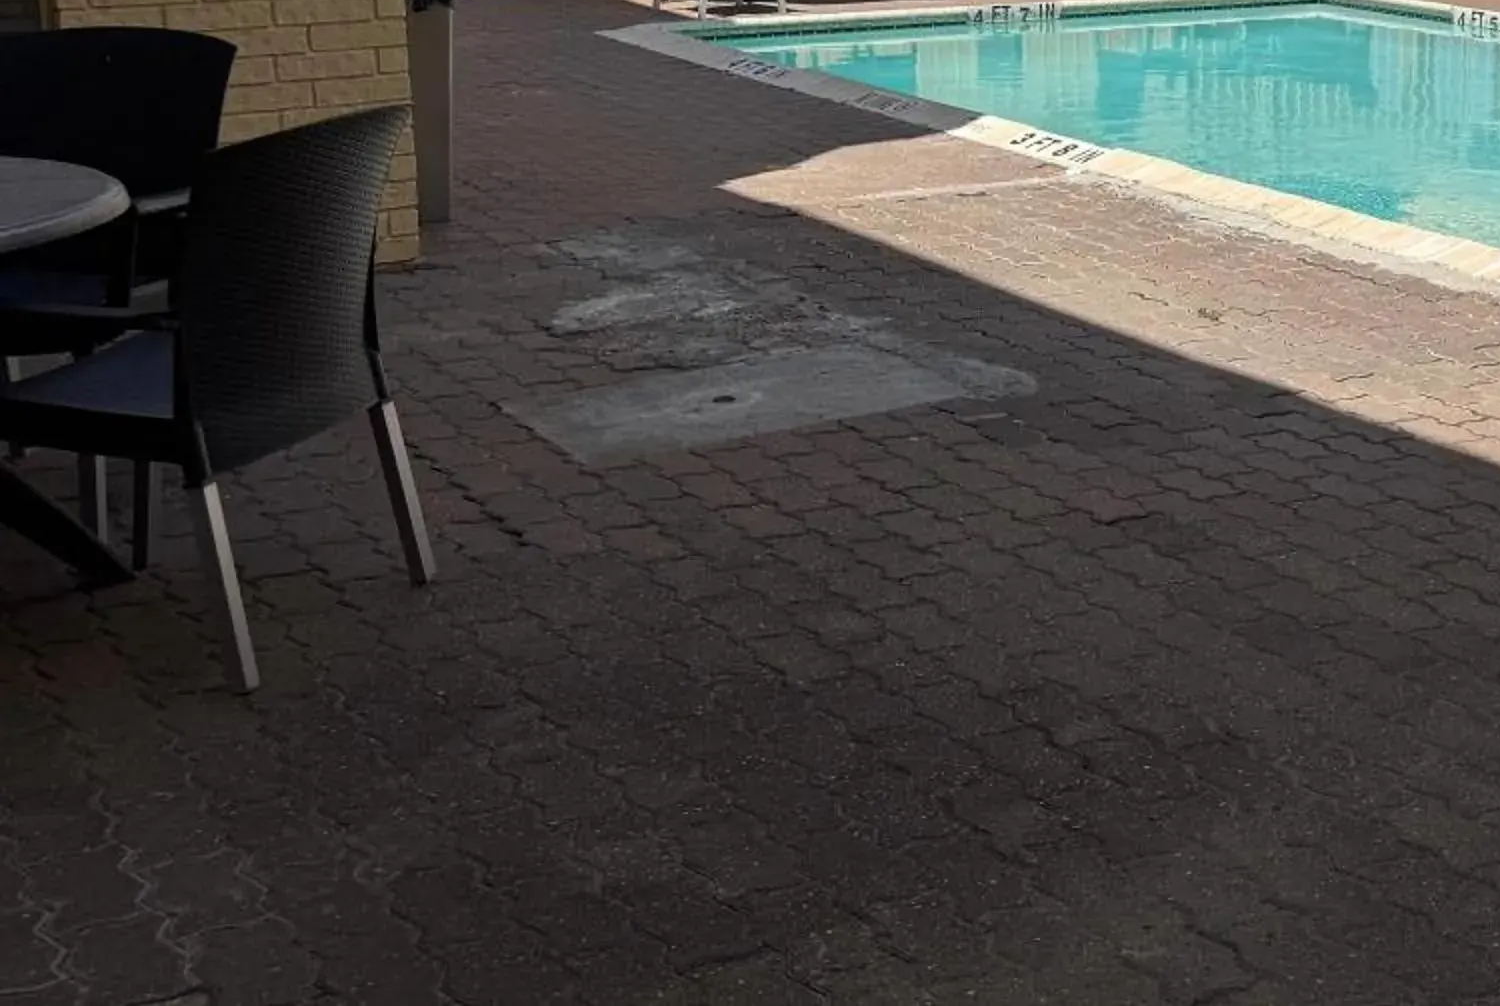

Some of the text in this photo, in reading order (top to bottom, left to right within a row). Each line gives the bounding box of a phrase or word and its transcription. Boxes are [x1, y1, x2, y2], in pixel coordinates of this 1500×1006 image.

[973, 2, 1055, 24] 4 FT 7 IN
[1457, 11, 1466, 27] 4
[1471, 11, 1486, 29] FT
[1490, 16, 1499, 32] 5
[1009, 132, 1105, 164] 3 FT 8 IN
